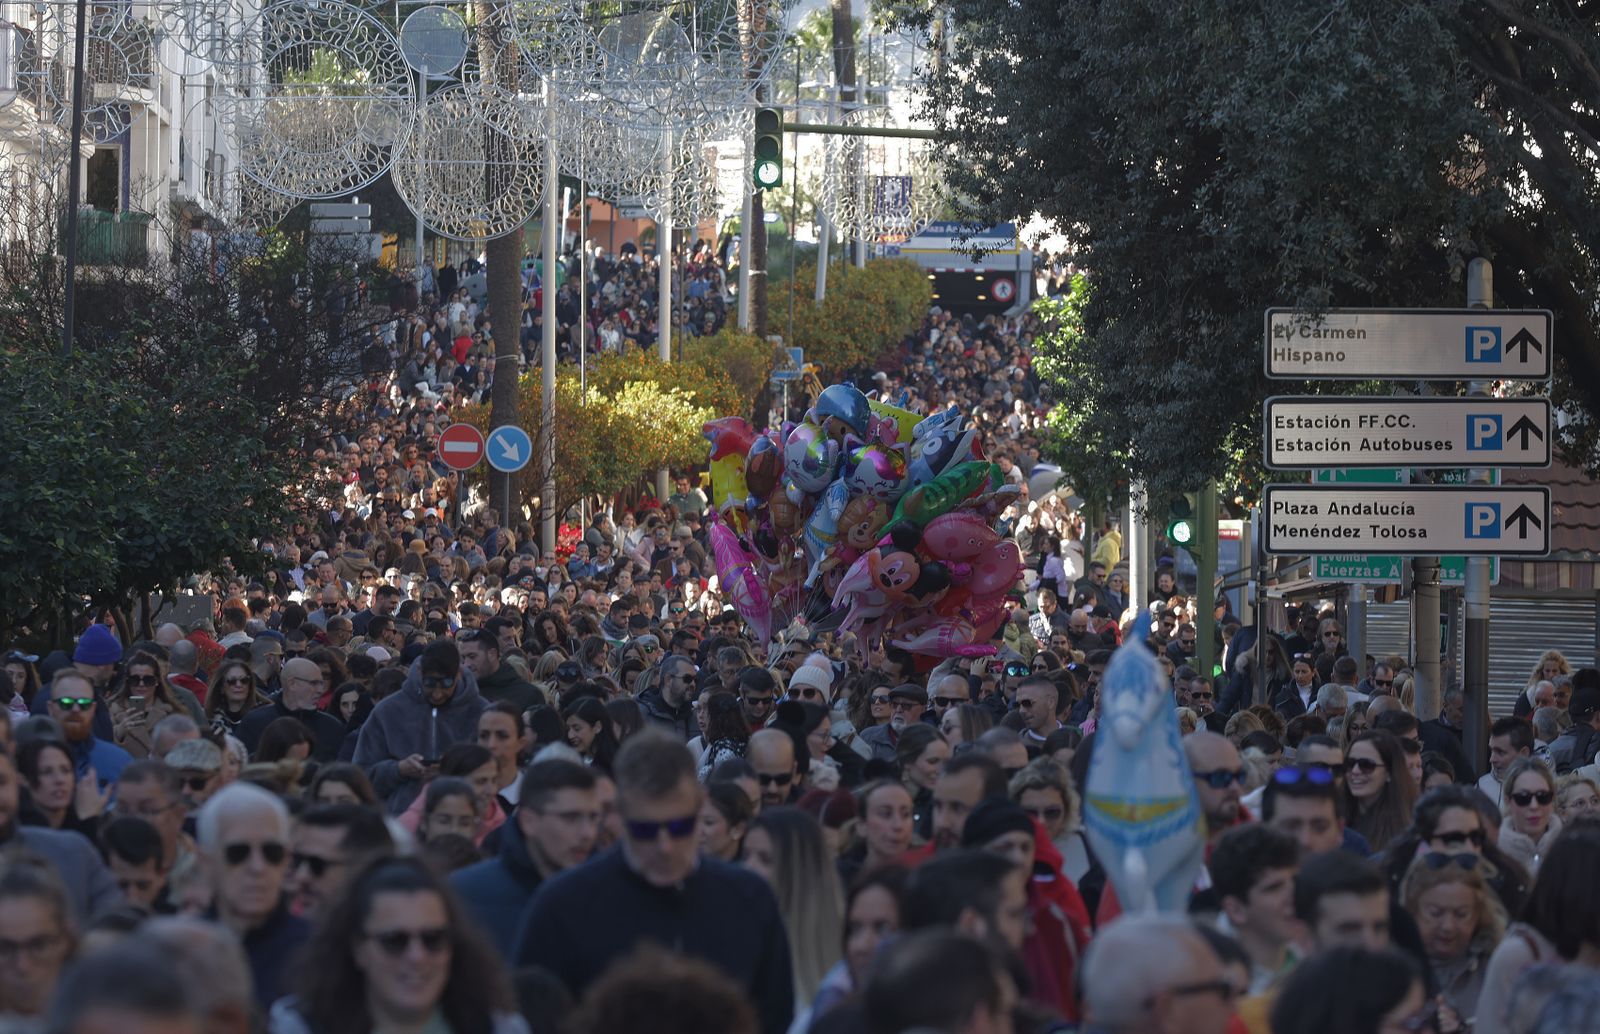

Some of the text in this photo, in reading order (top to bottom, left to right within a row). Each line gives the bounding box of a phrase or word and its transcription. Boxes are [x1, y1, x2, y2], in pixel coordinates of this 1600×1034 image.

[1299, 325, 1367, 339] Carmen
[1473, 330, 1497, 360] P
[1273, 348, 1346, 364] Hispano
[1274, 415, 1416, 429] Estación FF.CC.
[1474, 418, 1498, 448] P
[1274, 438, 1453, 452] Estación Autobuses
[1273, 501, 1416, 516] Plaza Andalucía
[1472, 506, 1496, 536] P
[1273, 523, 1427, 539] Menéndez Tolosa
[1320, 563, 1380, 577] Fuerzas
